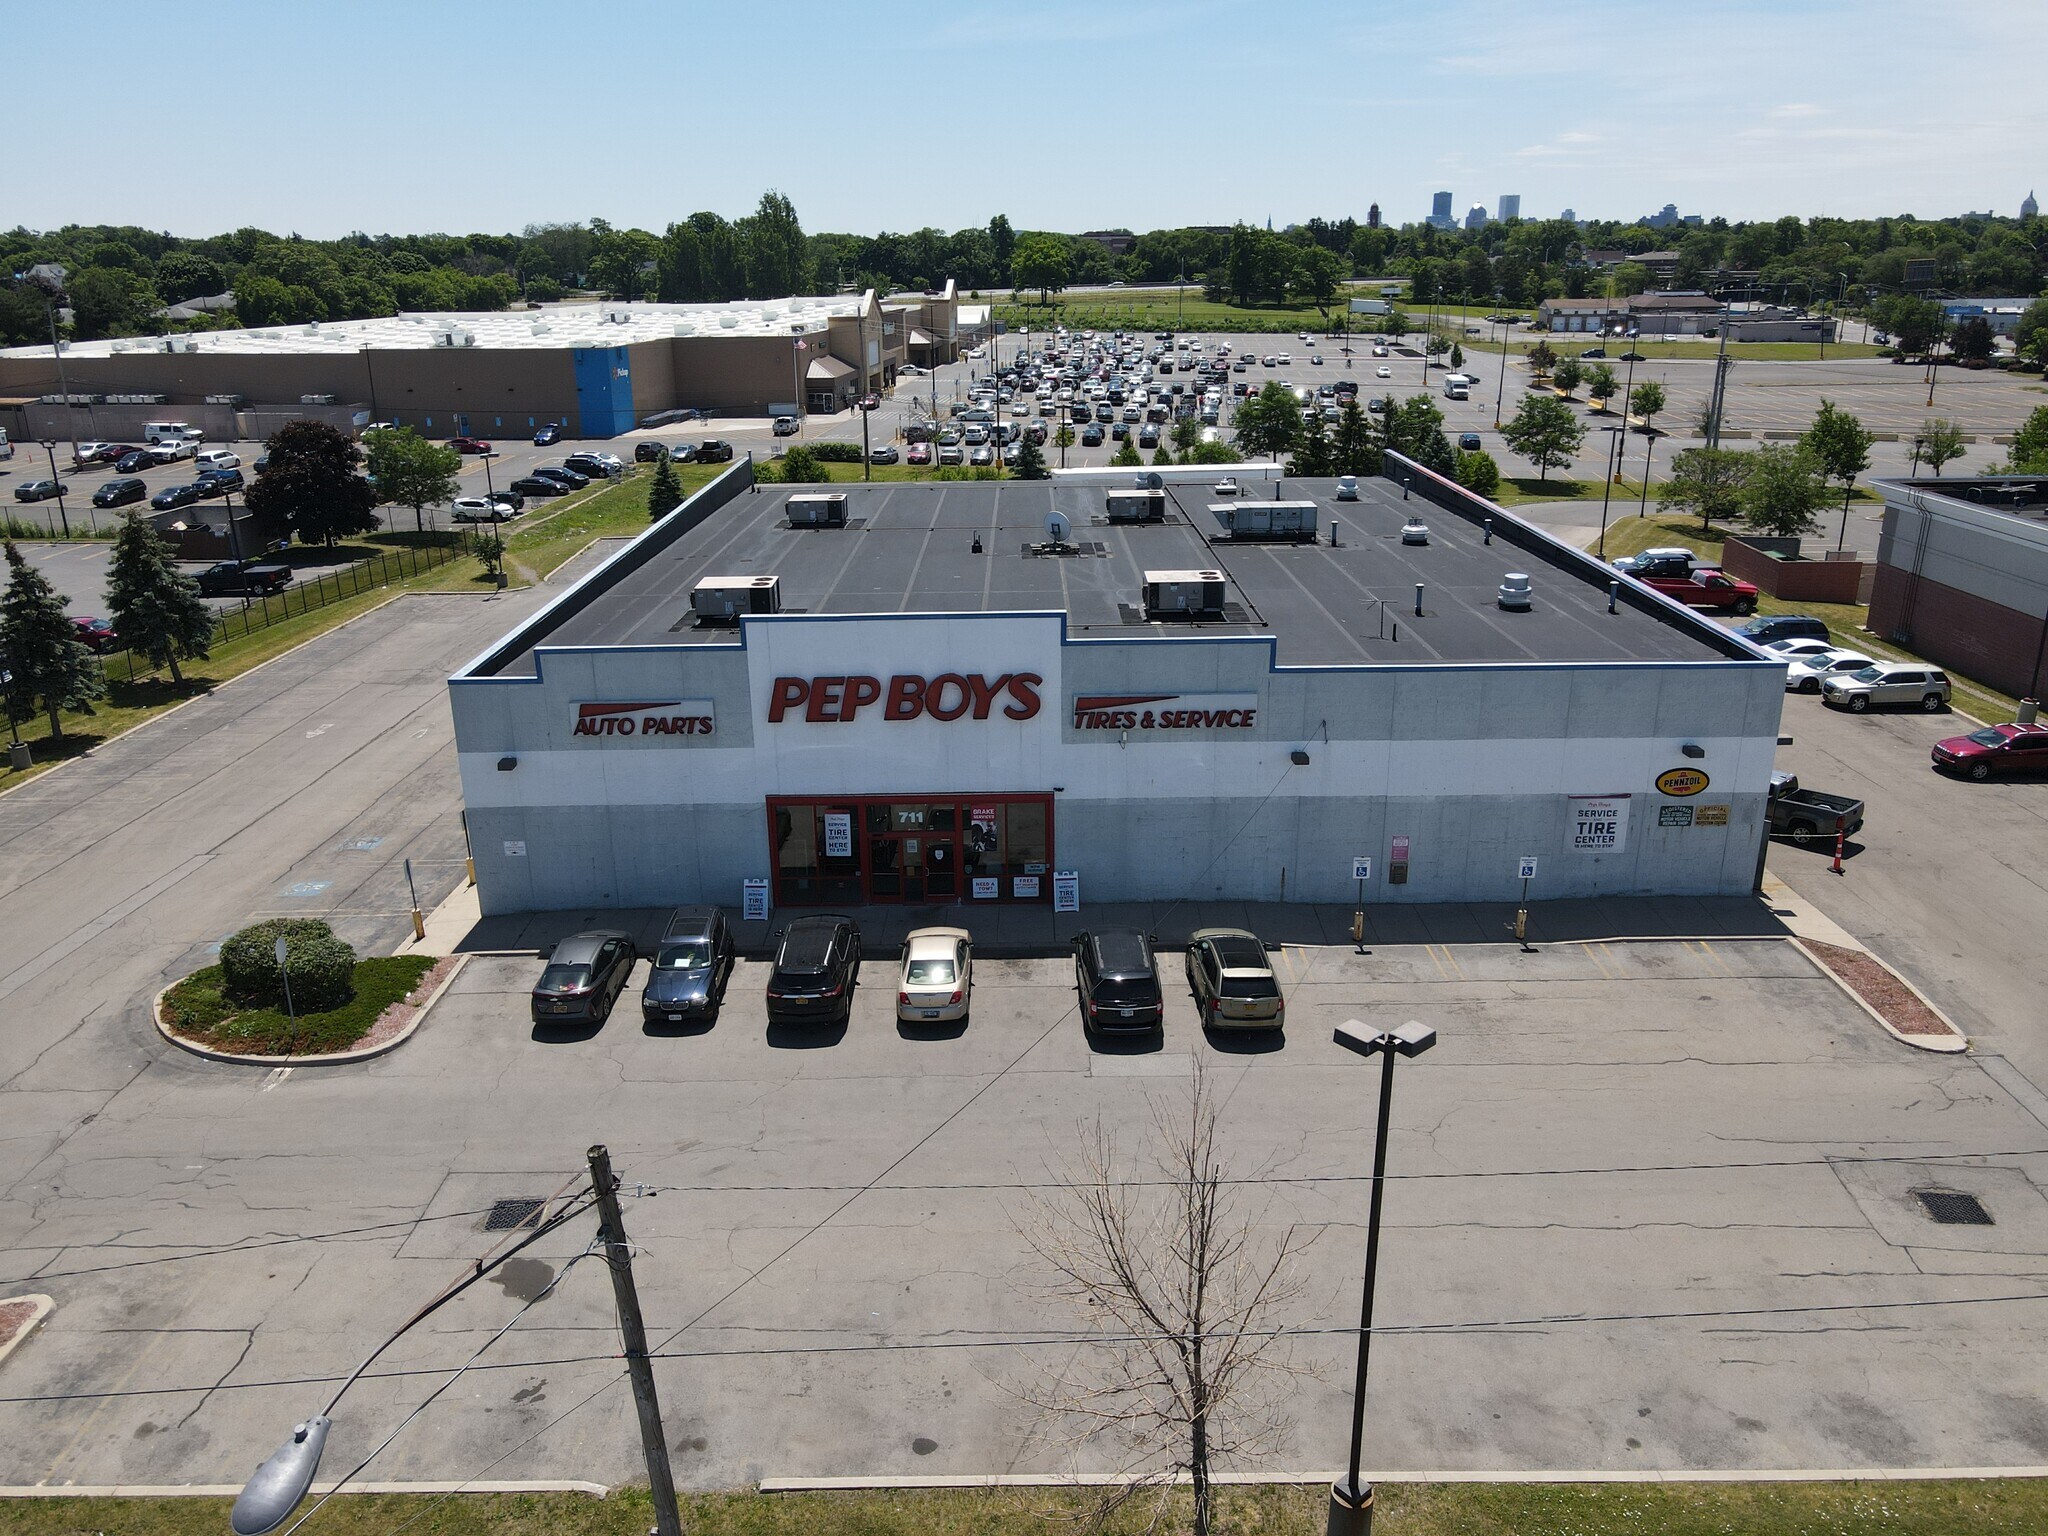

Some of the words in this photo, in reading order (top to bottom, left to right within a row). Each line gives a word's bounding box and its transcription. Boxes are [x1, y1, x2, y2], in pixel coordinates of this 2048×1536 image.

[768, 675, 882, 723] PEP
[884, 672, 1043, 721] BOYS
[1074, 711, 1137, 730] TIRES
[1141, 711, 1156, 729] &
[1158, 709, 1257, 729] SERVICE
[573, 717, 636, 736] AUTO
[641, 716, 713, 735] PARTS
[1664, 776, 1701, 788] PENNZOIL
[899, 811, 924, 823] 711
[1578, 809, 1619, 817] SERVICE
[1577, 822, 1617, 835] TIRE
[1575, 835, 1615, 844] CENTER
